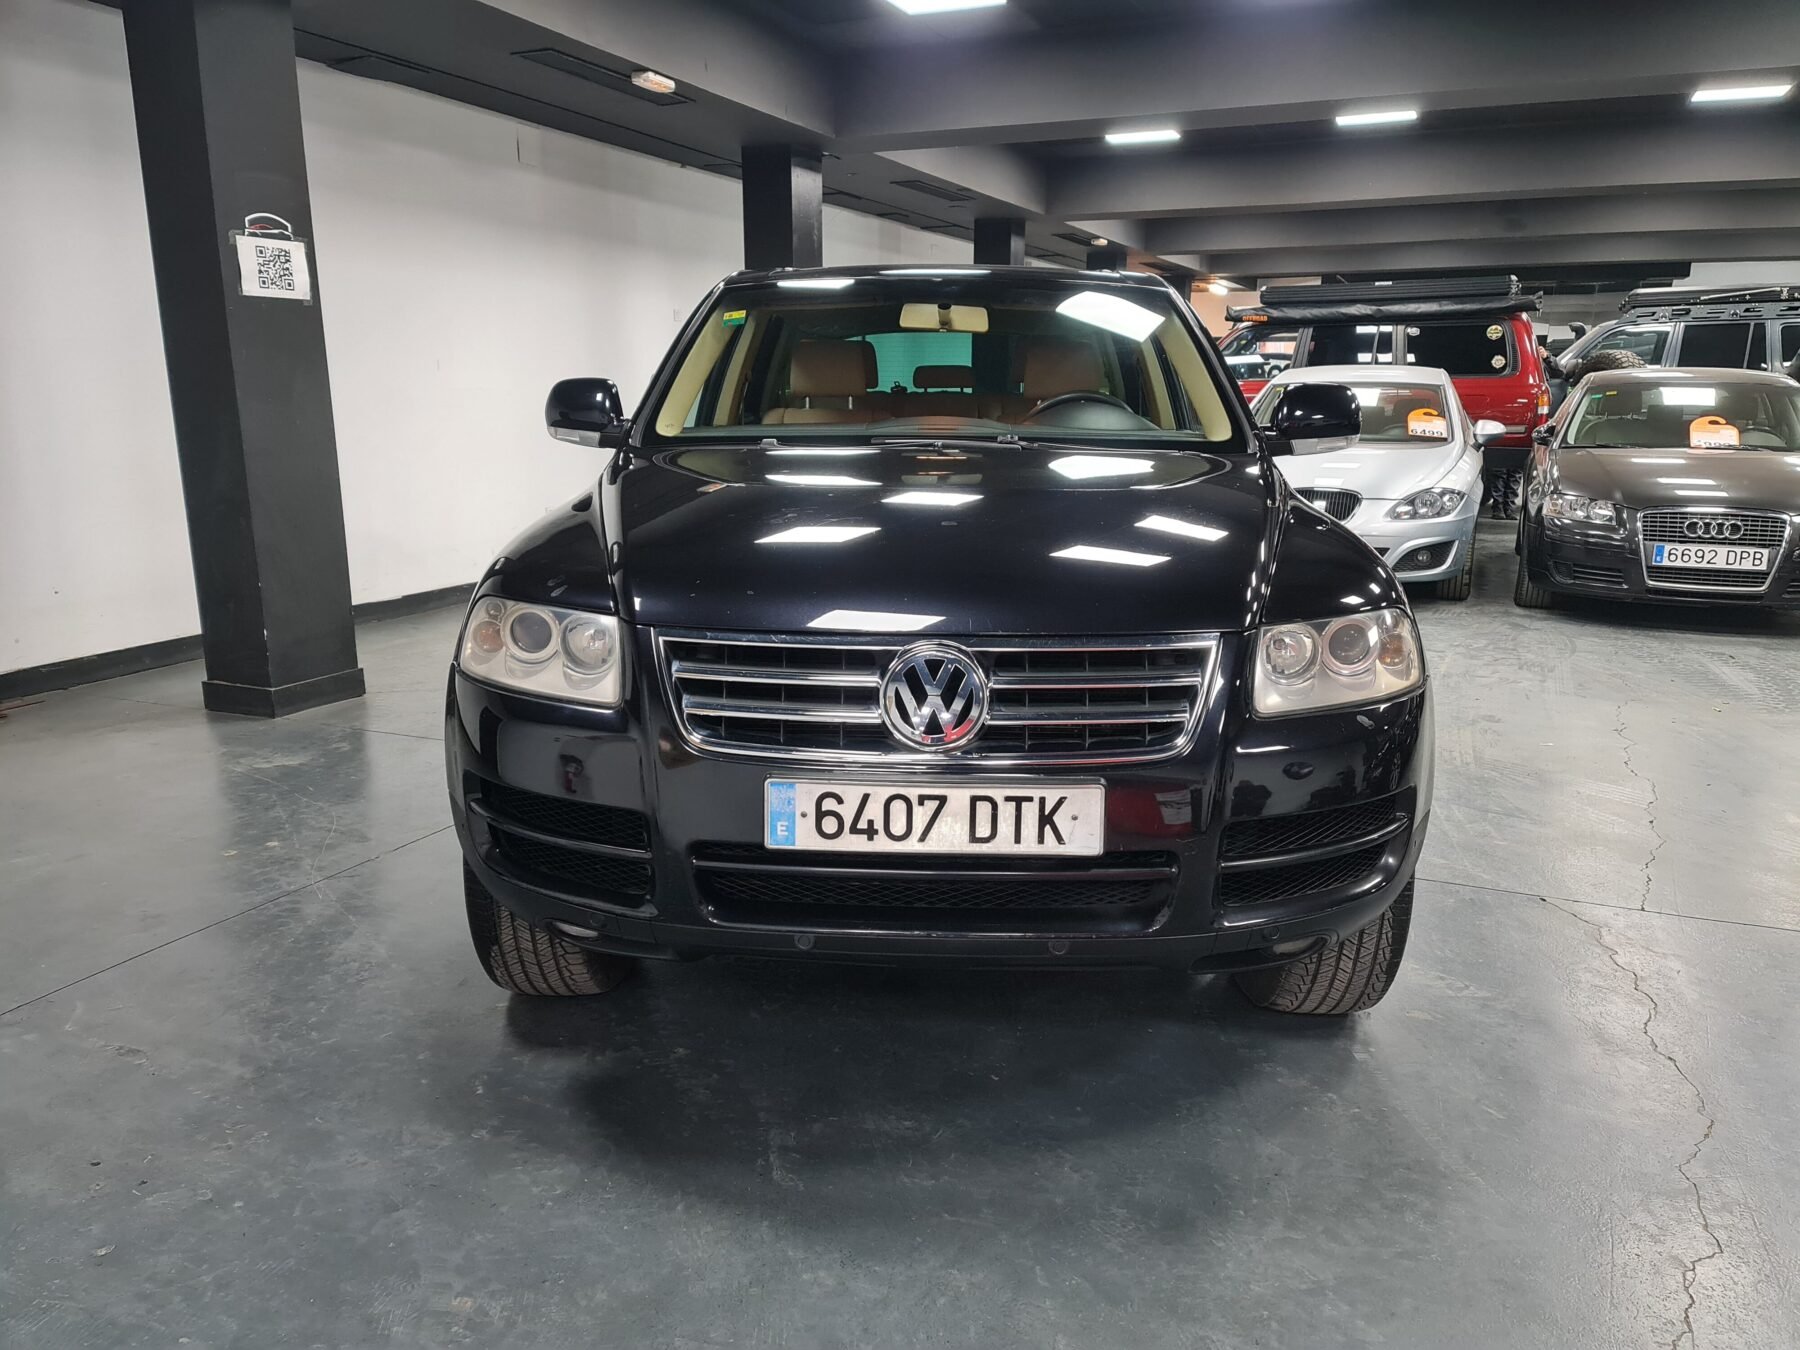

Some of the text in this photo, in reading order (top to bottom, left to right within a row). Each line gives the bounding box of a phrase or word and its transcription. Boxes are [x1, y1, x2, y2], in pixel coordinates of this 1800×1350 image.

[1410, 429, 1443, 437] 6499
[1667, 547, 1764, 567] 6692 DPB
[814, 791, 1068, 845] 6407 DTK
[777, 821, 789, 836] E
